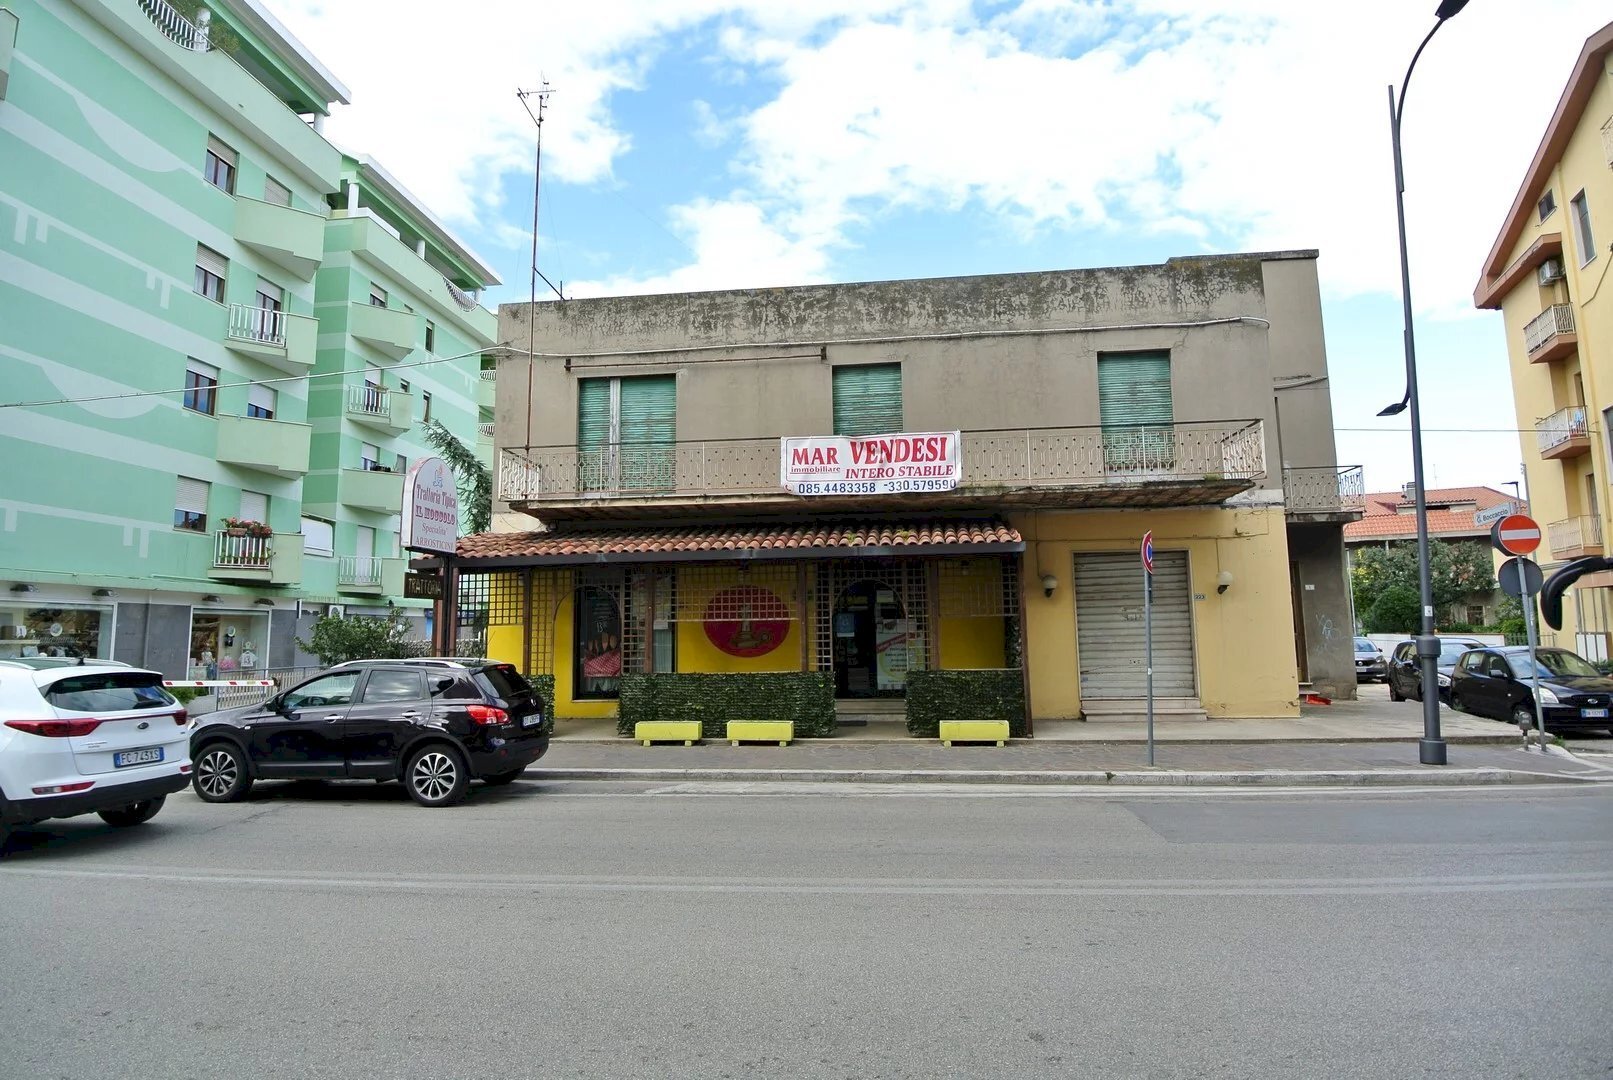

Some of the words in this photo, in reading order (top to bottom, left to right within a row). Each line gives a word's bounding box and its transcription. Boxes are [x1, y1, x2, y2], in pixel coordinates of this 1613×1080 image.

[792, 447, 839, 466] MAR
[850, 437, 948, 465] VENDESI
[791, 465, 841, 474] immobiliare
[845, 467, 895, 479] INTERO
[898, 464, 954, 477] STABILE
[416, 484, 441, 505] Trattoria
[798, 482, 876, 494] 085.4483358
[415, 505, 424, 518] IL
[1482, 508, 1509, 522] Boccaccio
